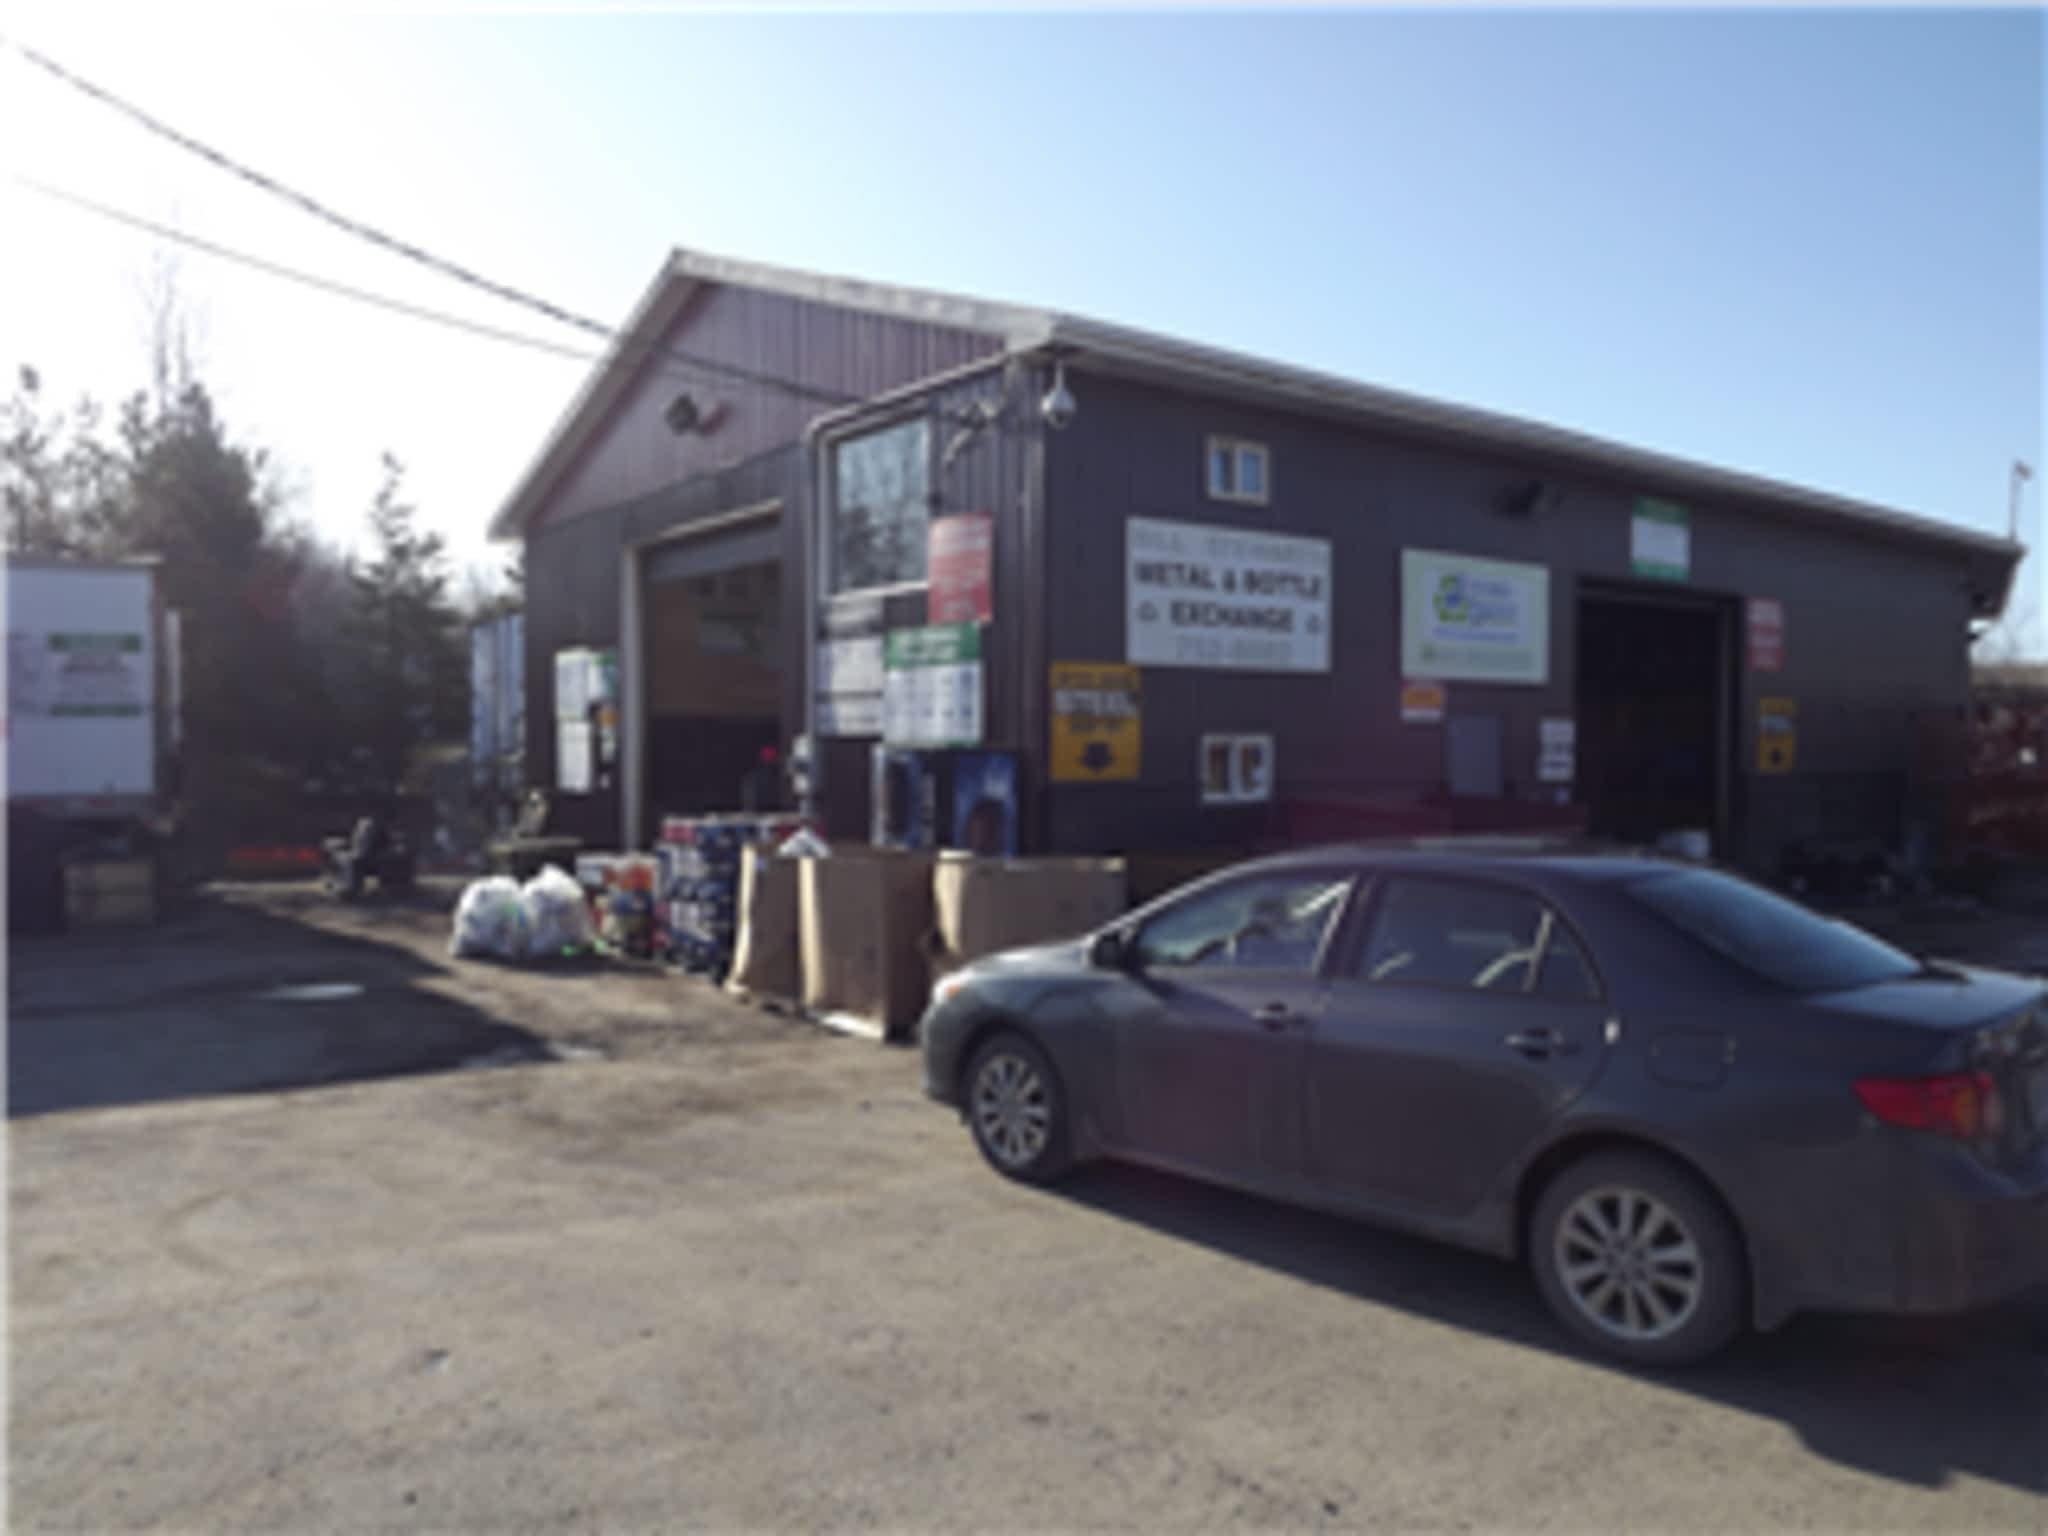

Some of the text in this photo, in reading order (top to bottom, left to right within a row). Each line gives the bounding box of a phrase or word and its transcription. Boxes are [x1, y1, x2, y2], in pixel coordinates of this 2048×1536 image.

[1134, 561, 1216, 591] METAL
[1242, 567, 1322, 600] BOTTLE
[1169, 600, 1295, 634] EXCHANGE
